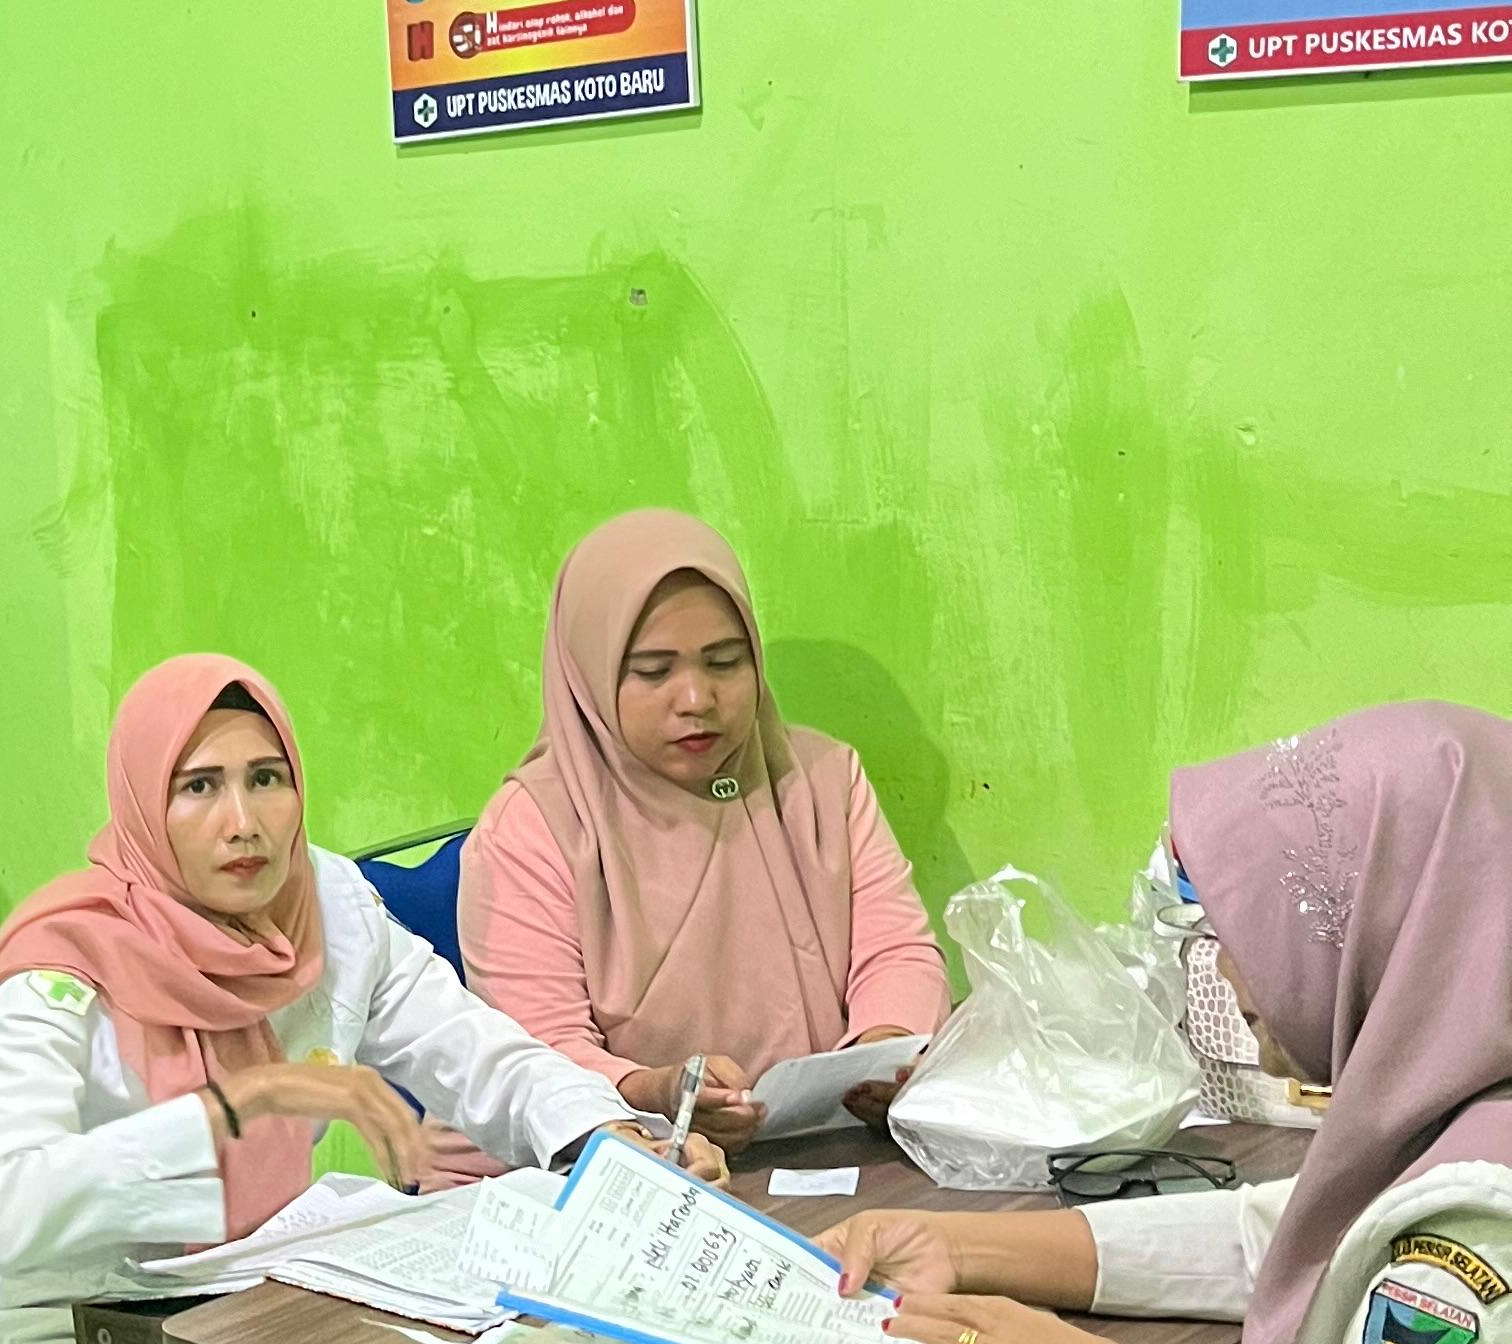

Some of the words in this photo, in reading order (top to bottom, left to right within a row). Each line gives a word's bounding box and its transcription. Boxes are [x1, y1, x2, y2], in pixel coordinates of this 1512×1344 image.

[1249, 35, 1297, 57] UPT
[1305, 23, 1461, 54] PUSKESMAS
[447, 93, 474, 117] UPT
[478, 80, 570, 113] PUSKESMAS
[574, 75, 616, 100] KOTO
[620, 68, 663, 95] BARU
